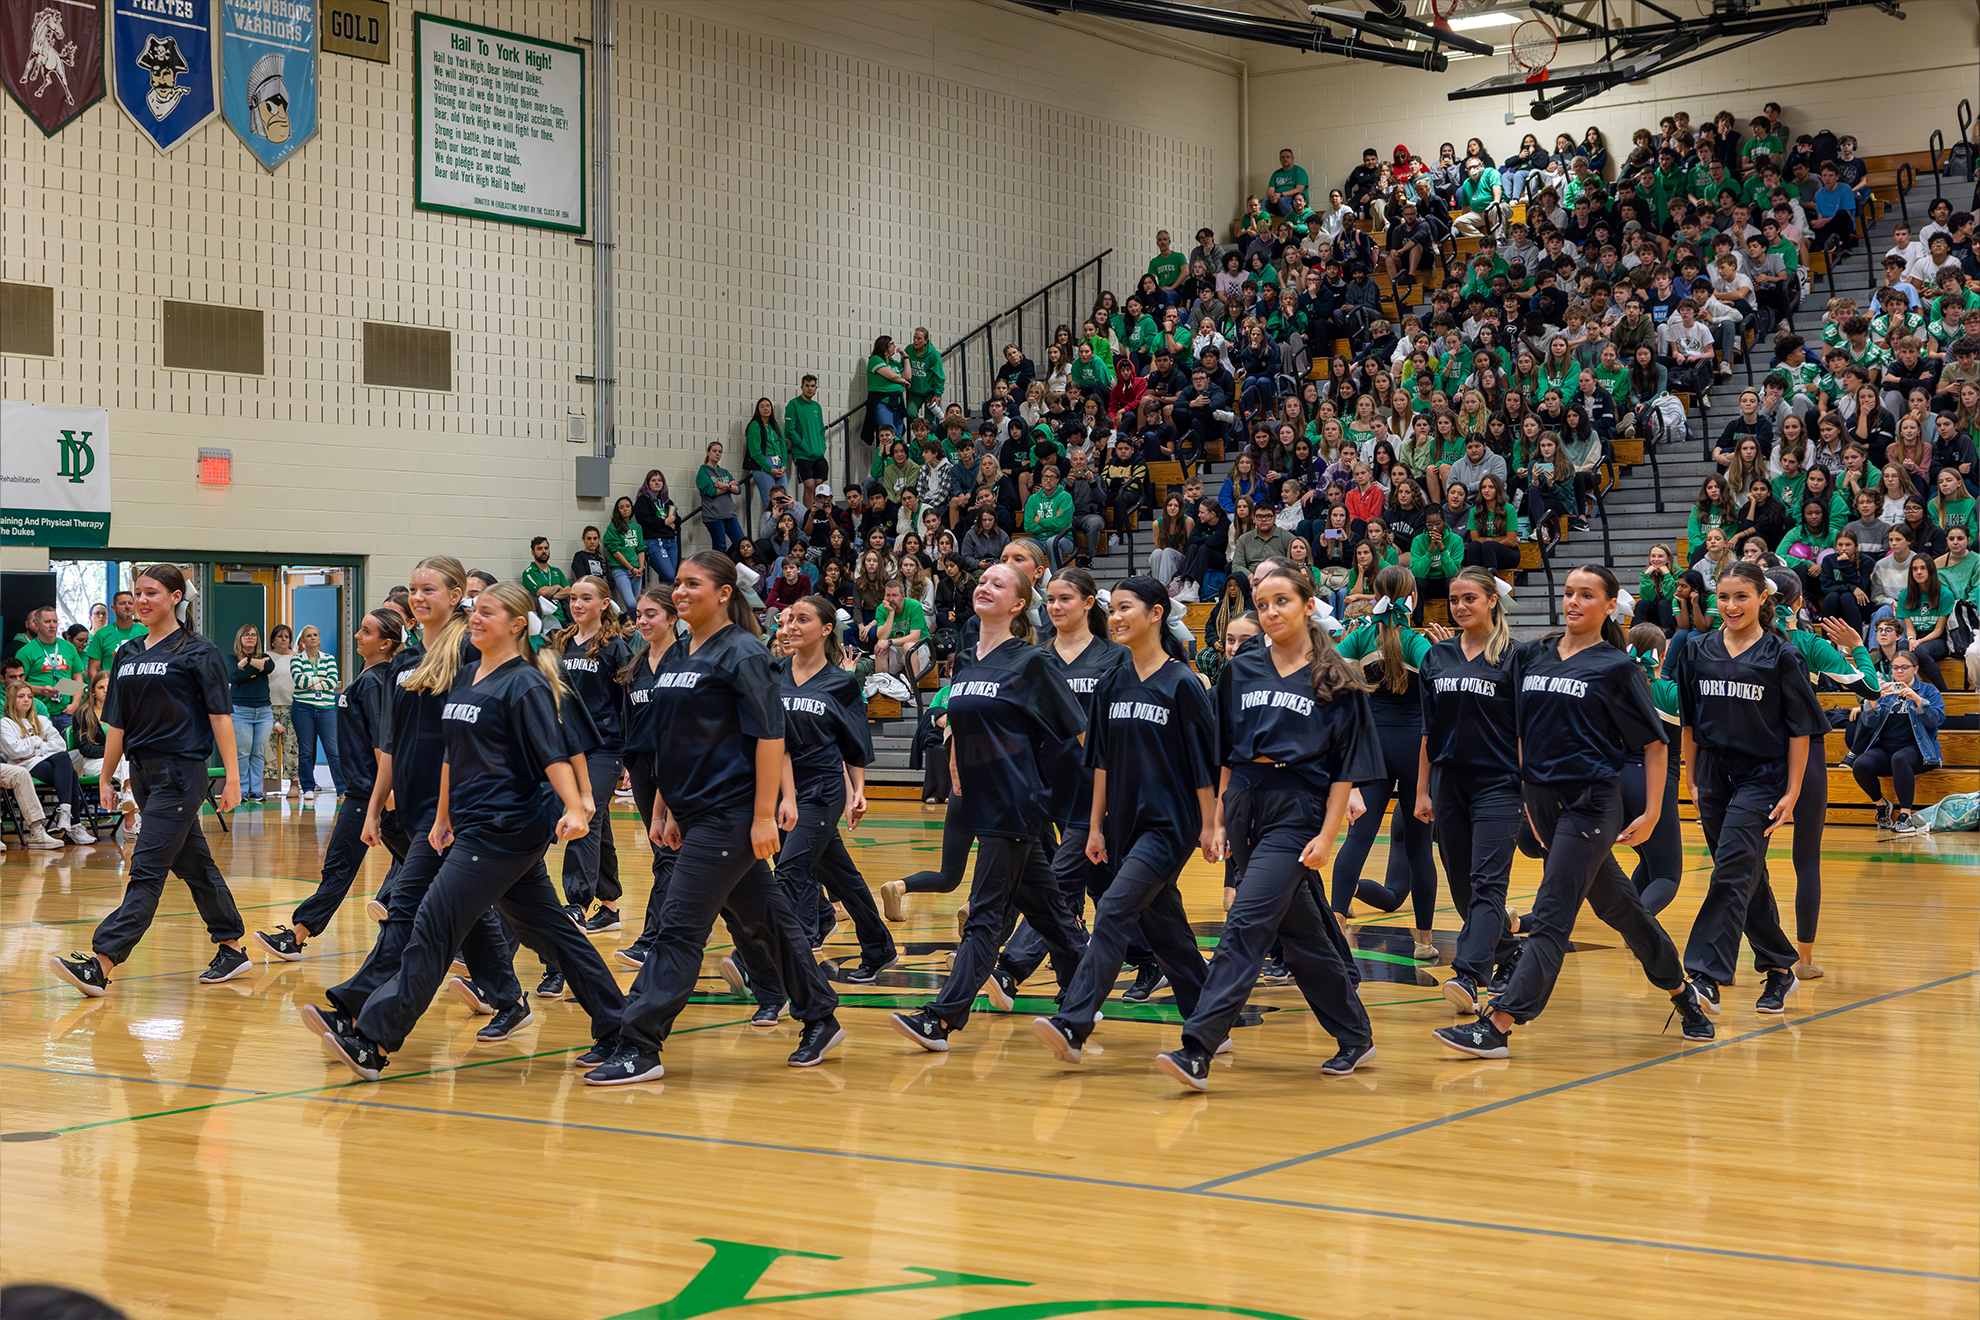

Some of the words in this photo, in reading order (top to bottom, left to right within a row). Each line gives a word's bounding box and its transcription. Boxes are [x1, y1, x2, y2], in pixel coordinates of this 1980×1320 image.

[234, 12, 302, 42] WARRIORS
[331, 9, 380, 46] GOLD
[451, 33, 471, 53] Hail
[477, 38, 489, 56] To
[496, 43, 520, 64] York
[525, 49, 552, 71] High!
[434, 50, 445, 64] Hail
[448, 55, 453, 65] to
[456, 55, 468, 68] York
[471, 59, 485, 74] High,
[487, 62, 500, 76] Dear
[502, 66, 523, 80] beloved
[526, 71, 544, 86] Dukes,
[434, 64, 443, 76] We
[445, 68, 456, 79] will
[459, 71, 478, 86] always
[481, 75, 493, 90] sing
[495, 78, 501, 89] in
[503, 80, 518, 93] joyful
[521, 85, 539, 98] praise;
[11, 527, 36, 536] Dukes
[24, 517, 40, 526] And
[41, 517, 72, 528] Physical
[73, 518, 104, 530] Therapy
[137, 662, 168, 675] DUKES
[573, 658, 600, 673] DUKES
[671, 672, 701, 688] DUKES
[963, 681, 1000, 698] DUKES
[1460, 677, 1497, 697] DUKES
[1547, 677, 1588, 699] DUKES
[1727, 681, 1765, 701] DUKES
[792, 697, 827, 716] DUKES
[1241, 690, 1272, 711] YORK
[1270, 691, 1315, 716] DUKES
[453, 703, 482, 724] DUKES
[1133, 702, 1170, 725] DUKES
